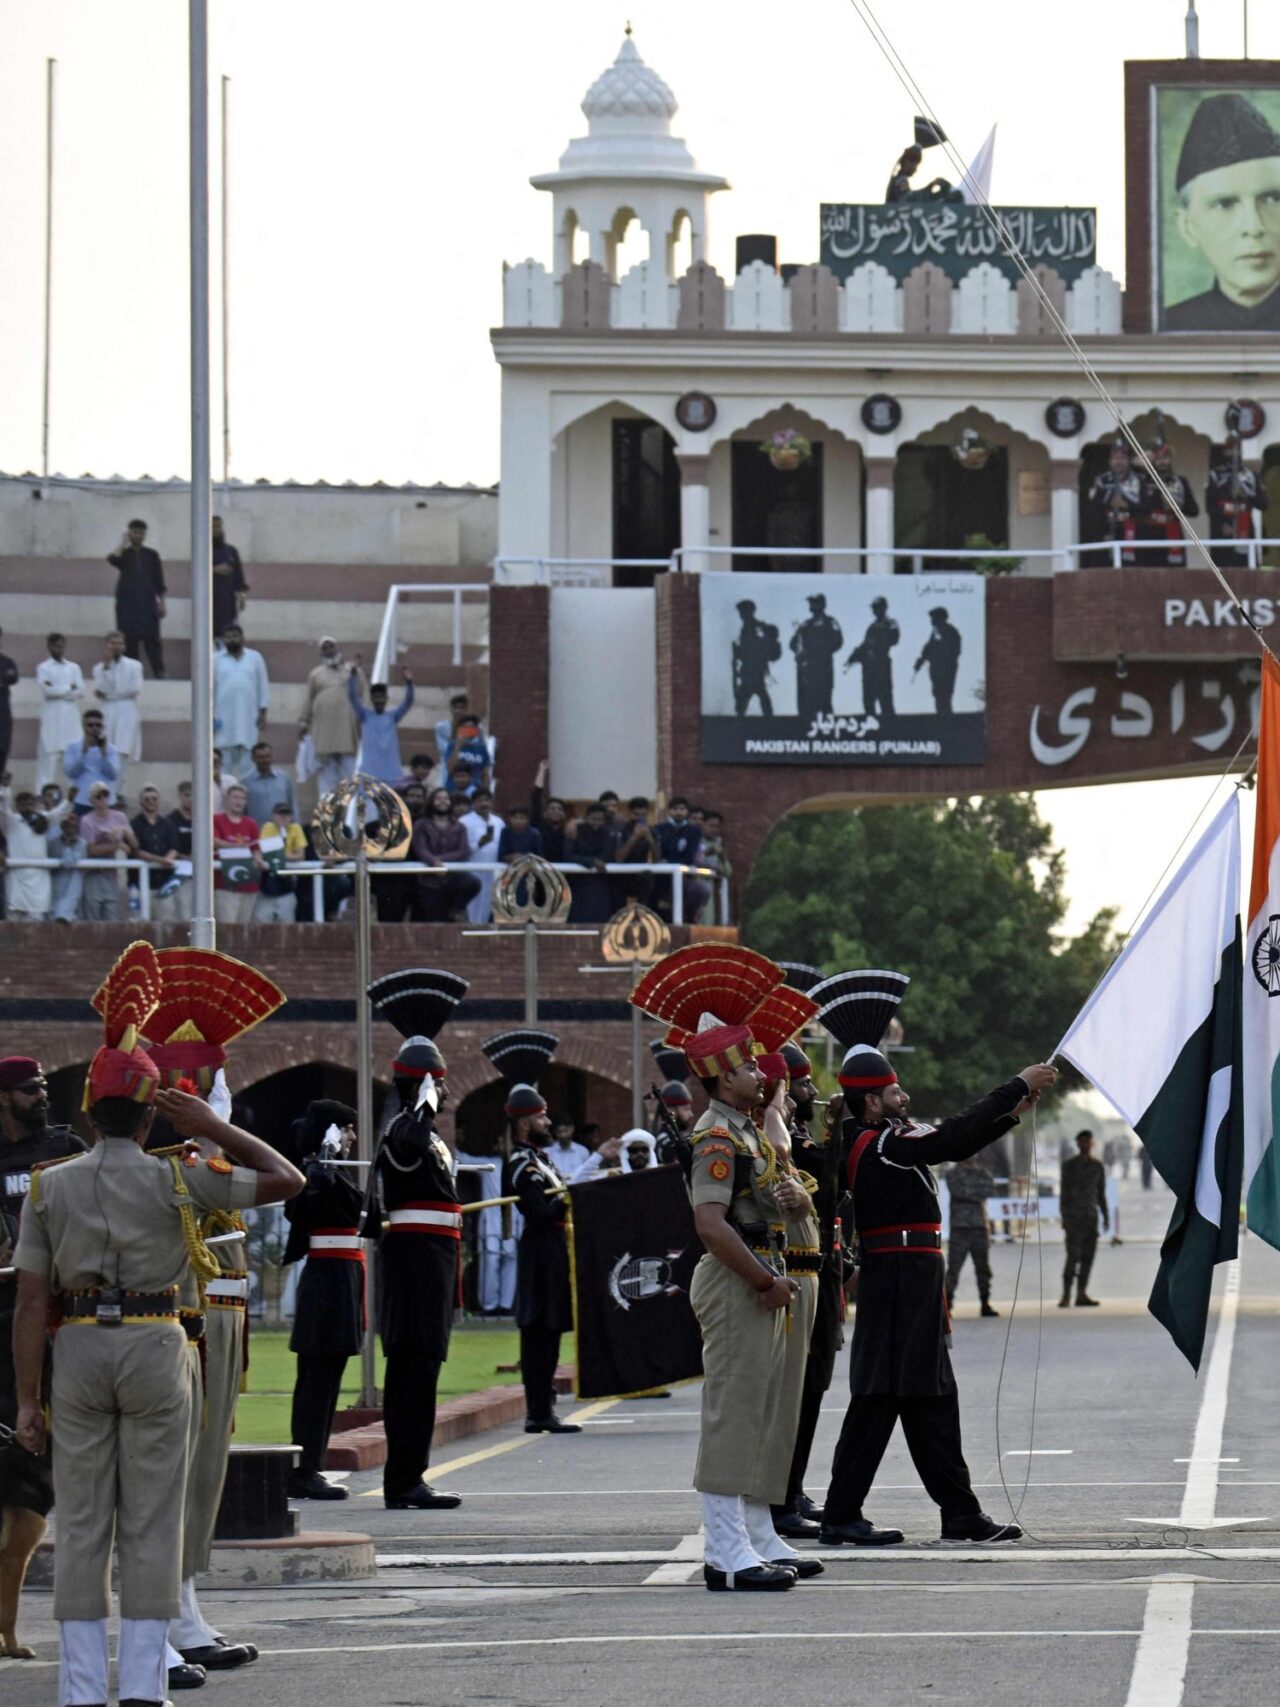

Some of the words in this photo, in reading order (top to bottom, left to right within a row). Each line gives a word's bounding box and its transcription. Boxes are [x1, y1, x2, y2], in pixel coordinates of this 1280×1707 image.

[745, 740, 809, 754] PAKISTAN
[812, 740, 876, 754] RANGERS
[879, 740, 941, 756] (PUNJAB)
[1002, 1202, 1039, 1216] STOP
